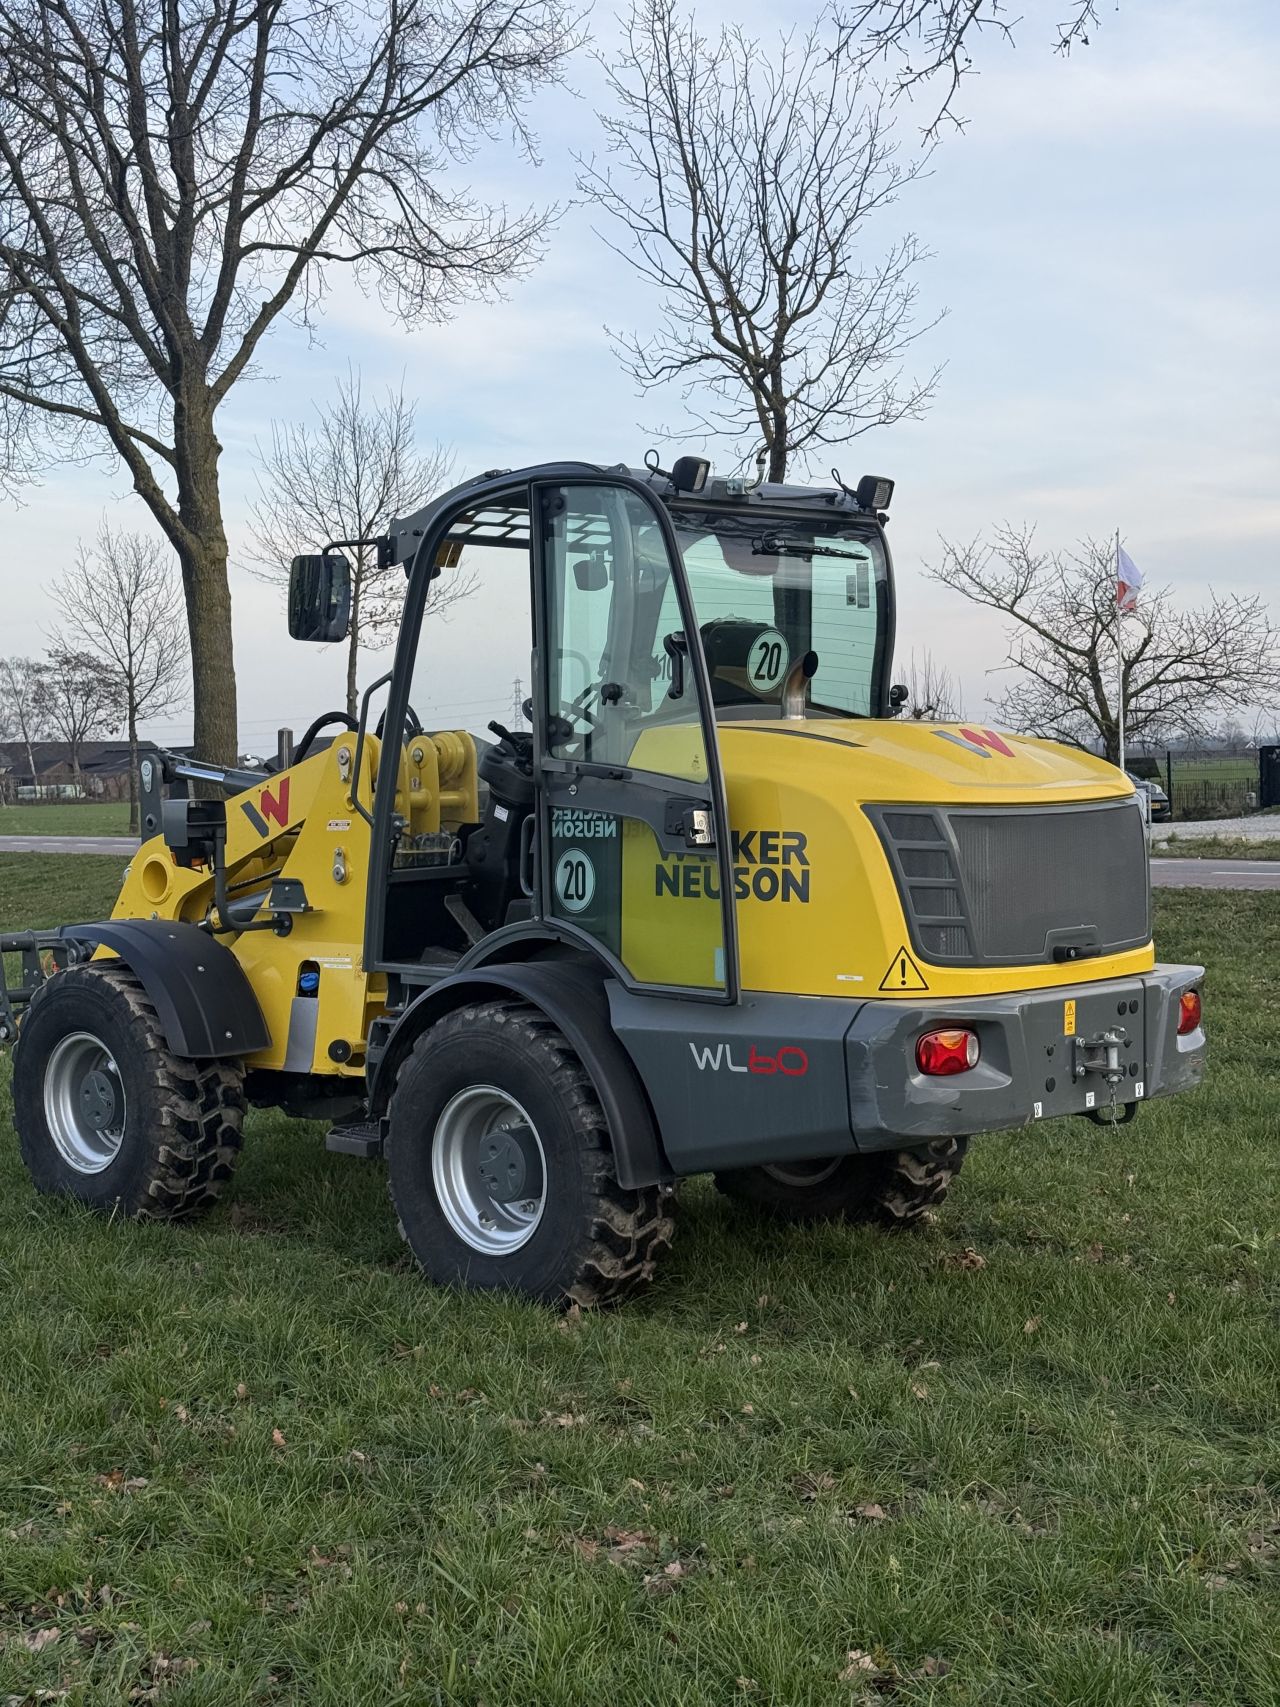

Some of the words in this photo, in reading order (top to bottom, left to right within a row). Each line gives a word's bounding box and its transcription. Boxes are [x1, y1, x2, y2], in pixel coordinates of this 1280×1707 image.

[754, 641, 782, 681] 20
[563, 859, 587, 901] 20
[655, 863, 810, 904] NEUSON
[688, 1042, 809, 1077] WL60
